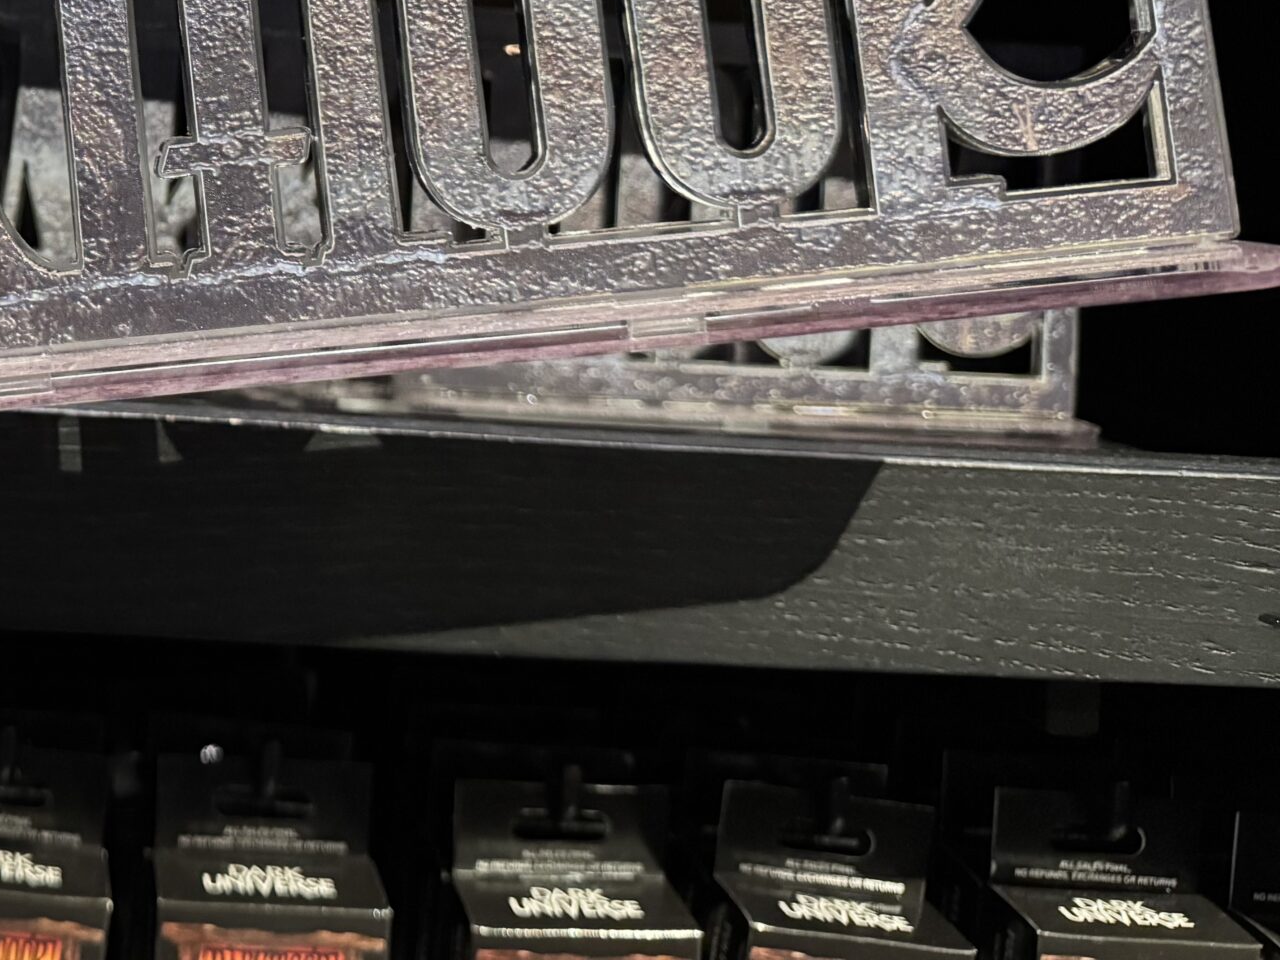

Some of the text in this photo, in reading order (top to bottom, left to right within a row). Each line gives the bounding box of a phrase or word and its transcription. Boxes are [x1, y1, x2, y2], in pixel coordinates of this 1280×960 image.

[202, 872, 338, 900] UNIVERSE
[508, 896, 645, 921] UNIVERSE
[1058, 905, 1195, 929] UNIVERSE
